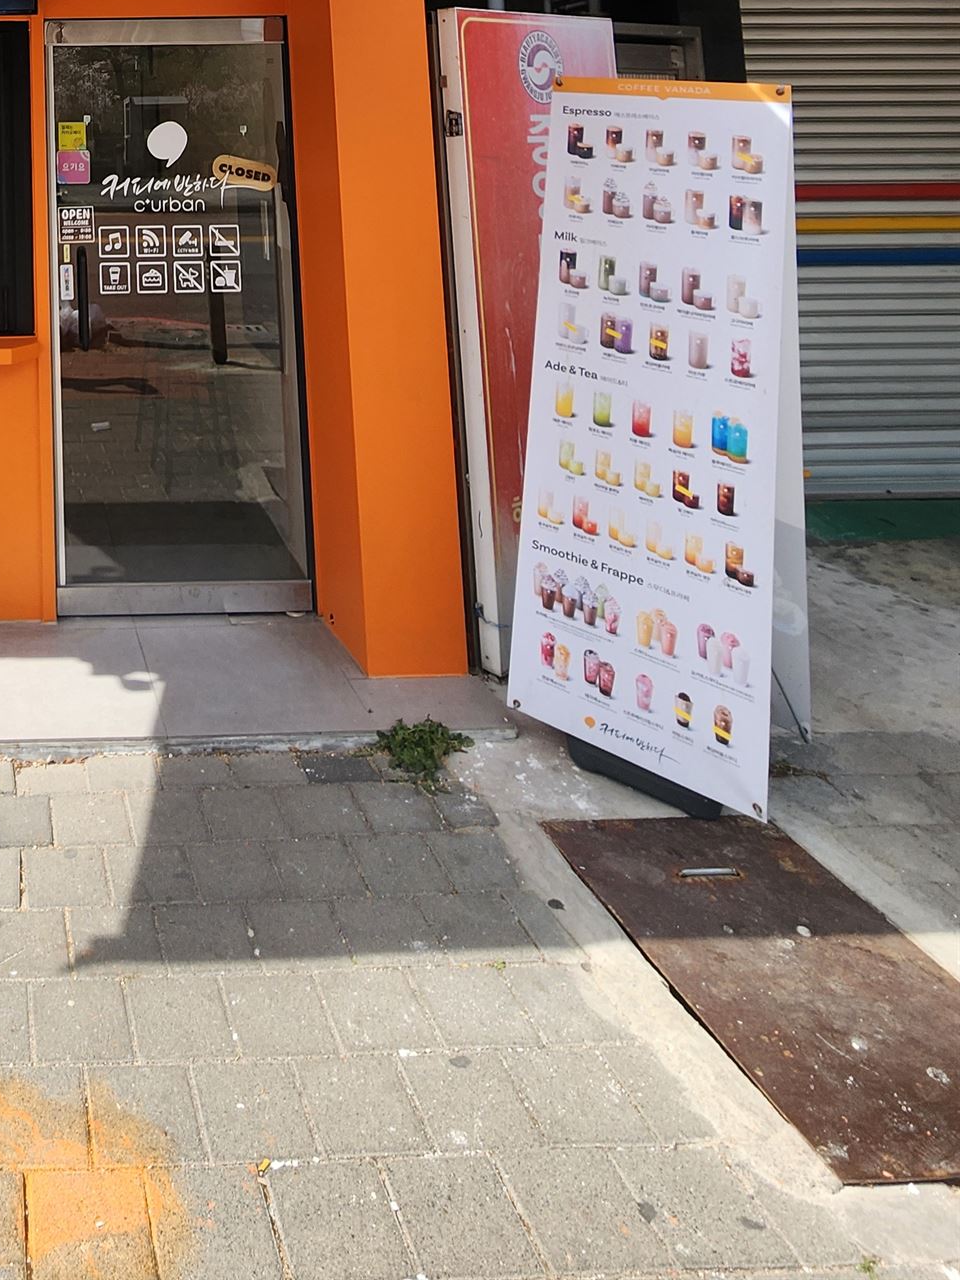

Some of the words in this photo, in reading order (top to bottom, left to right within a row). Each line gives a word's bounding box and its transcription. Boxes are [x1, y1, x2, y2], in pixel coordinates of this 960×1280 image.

[617, 83, 660, 93] COFFEE
[665, 85, 711, 95] VANADA
[562, 105, 612, 117] Espresso
[62, 162, 85, 171] 요기요
[218, 163, 271, 183] CLOSED
[62, 209, 91, 220] OPEN
[554, 230, 578, 242] Milk
[545, 360, 567, 373] Ade
[569, 366, 577, 375] &
[579, 367, 598, 380] Tea
[532, 539, 589, 568] Smoothie
[590, 559, 599, 571] &
[601, 562, 644, 587] Frappe
